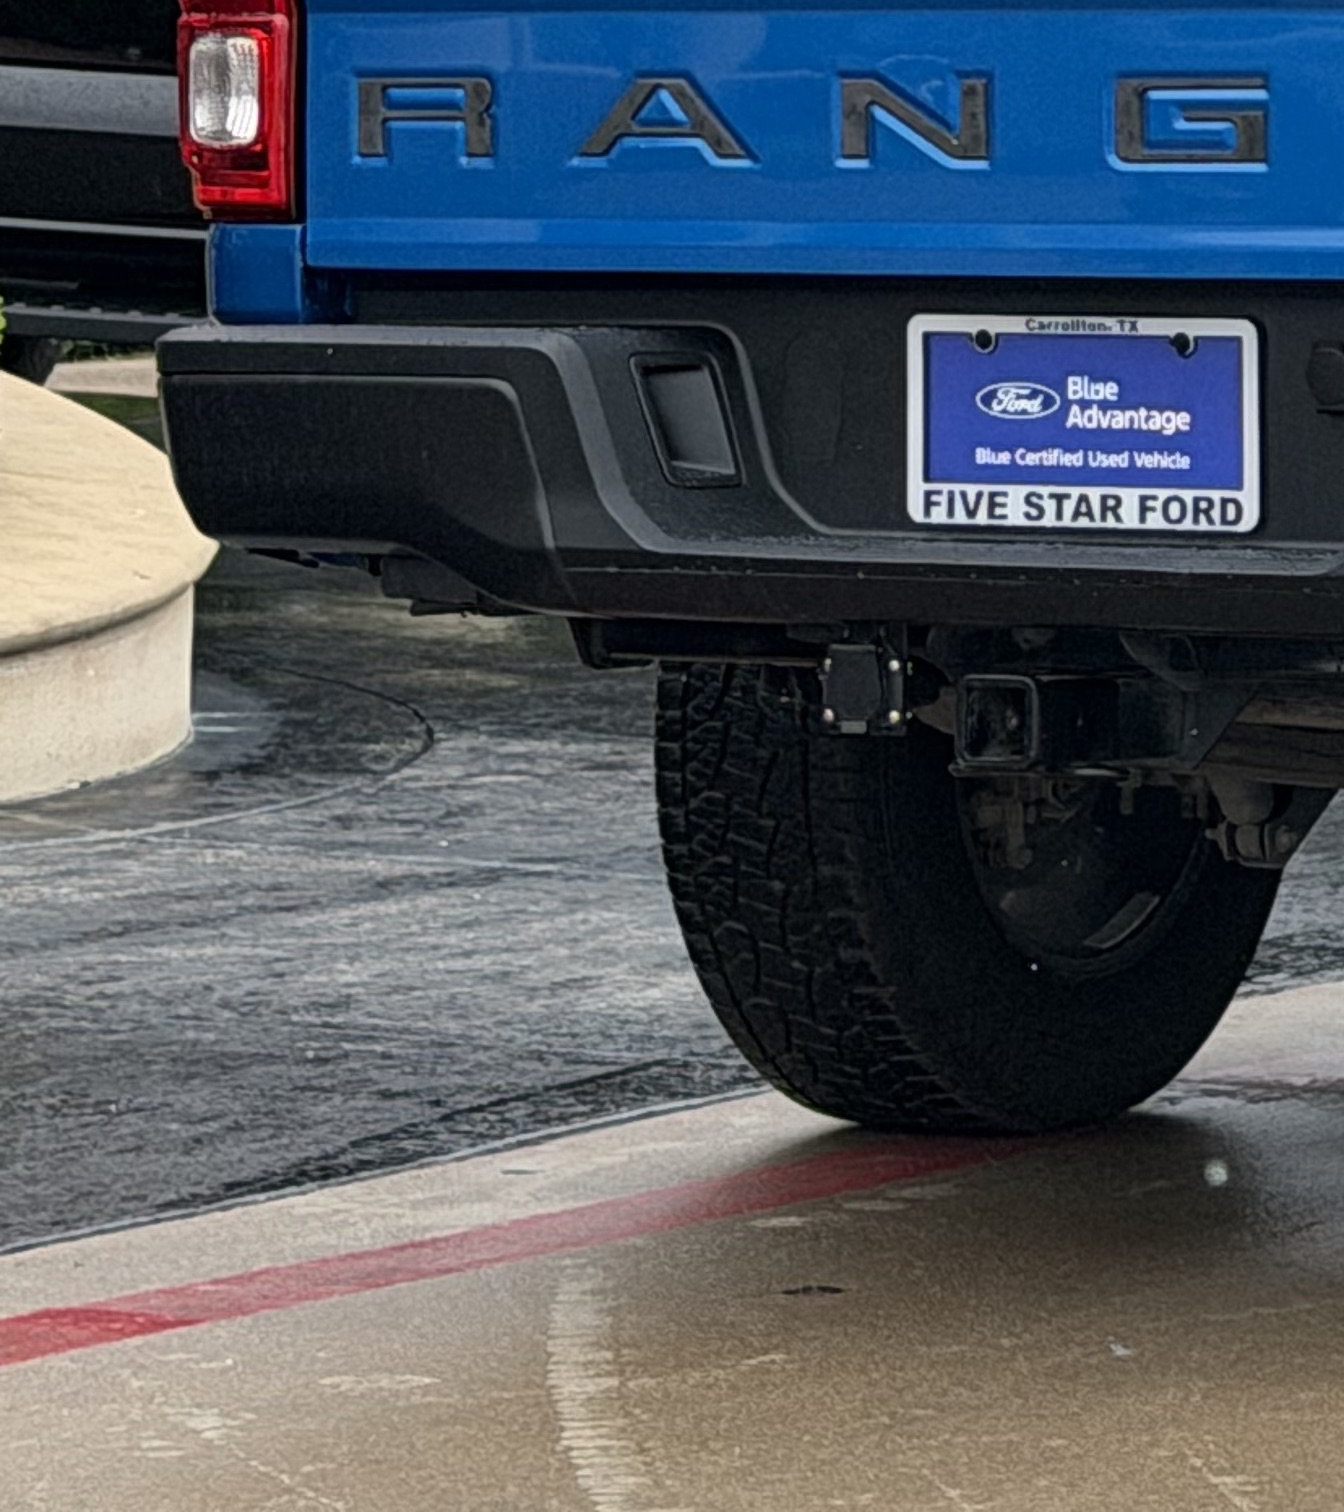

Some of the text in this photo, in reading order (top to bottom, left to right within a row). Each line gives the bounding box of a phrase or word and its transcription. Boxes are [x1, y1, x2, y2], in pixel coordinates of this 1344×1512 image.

[1116, 319, 1139, 333] TX
[991, 387, 1044, 414] Ford
[1066, 376, 1119, 401] Blue
[1066, 404, 1191, 435] Advantage
[975, 447, 1191, 470] Blue Certified Used Vehicle
[922, 489, 1243, 527] FIVE STAR FORD
